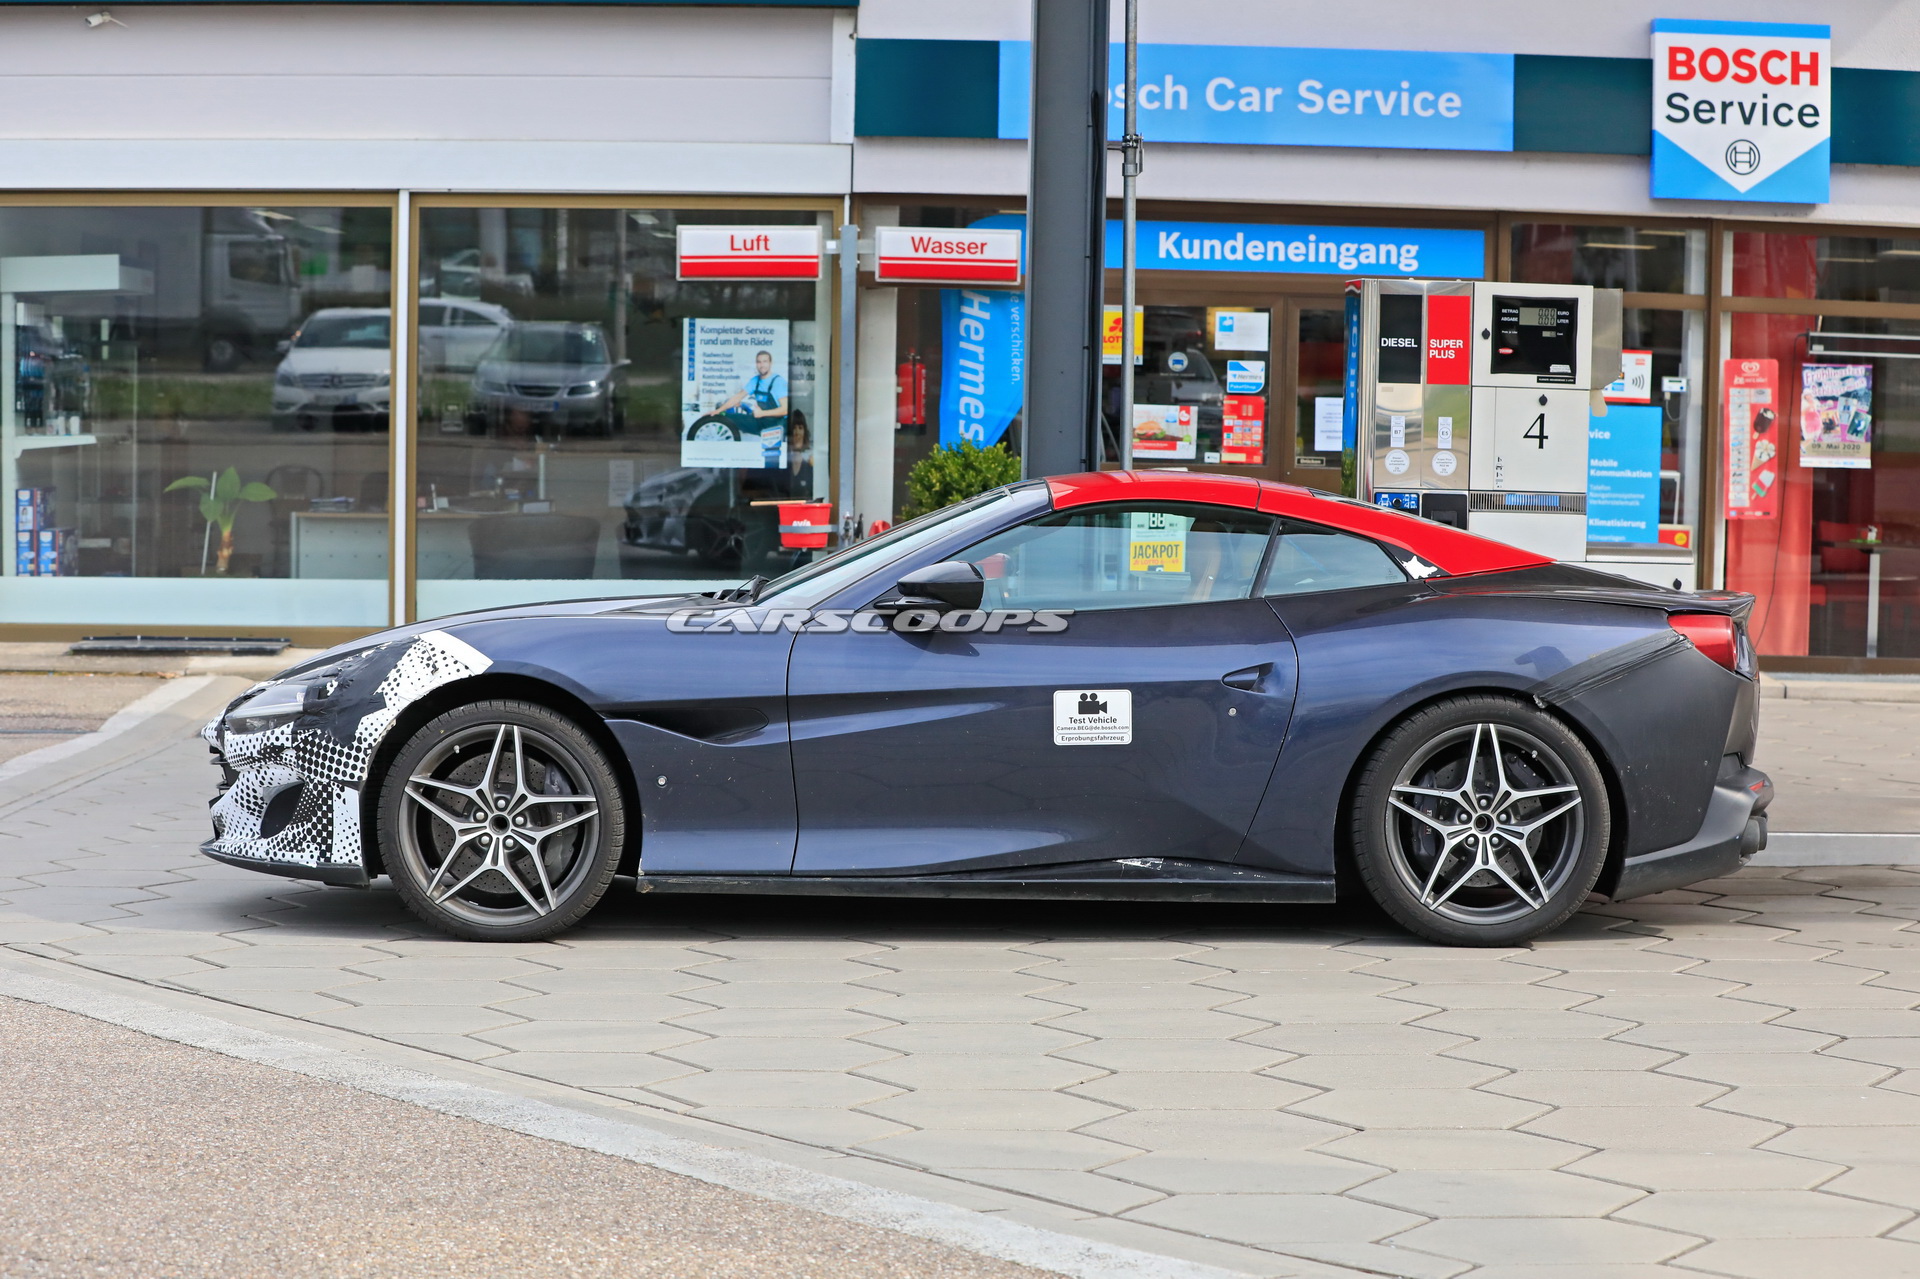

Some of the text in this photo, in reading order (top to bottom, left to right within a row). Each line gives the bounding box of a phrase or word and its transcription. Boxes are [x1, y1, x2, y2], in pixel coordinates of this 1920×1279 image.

[1668, 46, 1819, 86] BOSCH
[1108, 74, 1462, 118] sch Car Service
[1665, 92, 1820, 128] Service
[730, 235, 770, 251] Luft
[911, 236, 987, 255] Wasser
[1158, 231, 1419, 272] Kundeneingang
[700, 326, 775, 336] Kompletter Service
[700, 337, 719, 345] rund
[733, 337, 749, 346] Ihre
[750, 337, 773, 346] Räder
[1381, 337, 1418, 348] DIESEL
[1429, 339, 1464, 349] SUPER
[1429, 349, 1456, 359] PLUS
[959, 289, 990, 441] Hermes
[1522, 413, 1549, 449] 4
[1590, 458, 1618, 467] Mobile
[1589, 468, 1653, 478] Kommunikation
[1588, 518, 1647, 529] Klimatisierung
[1132, 544, 1180, 559] JACKPOT
[1087, 716, 1117, 724] Vehicle
